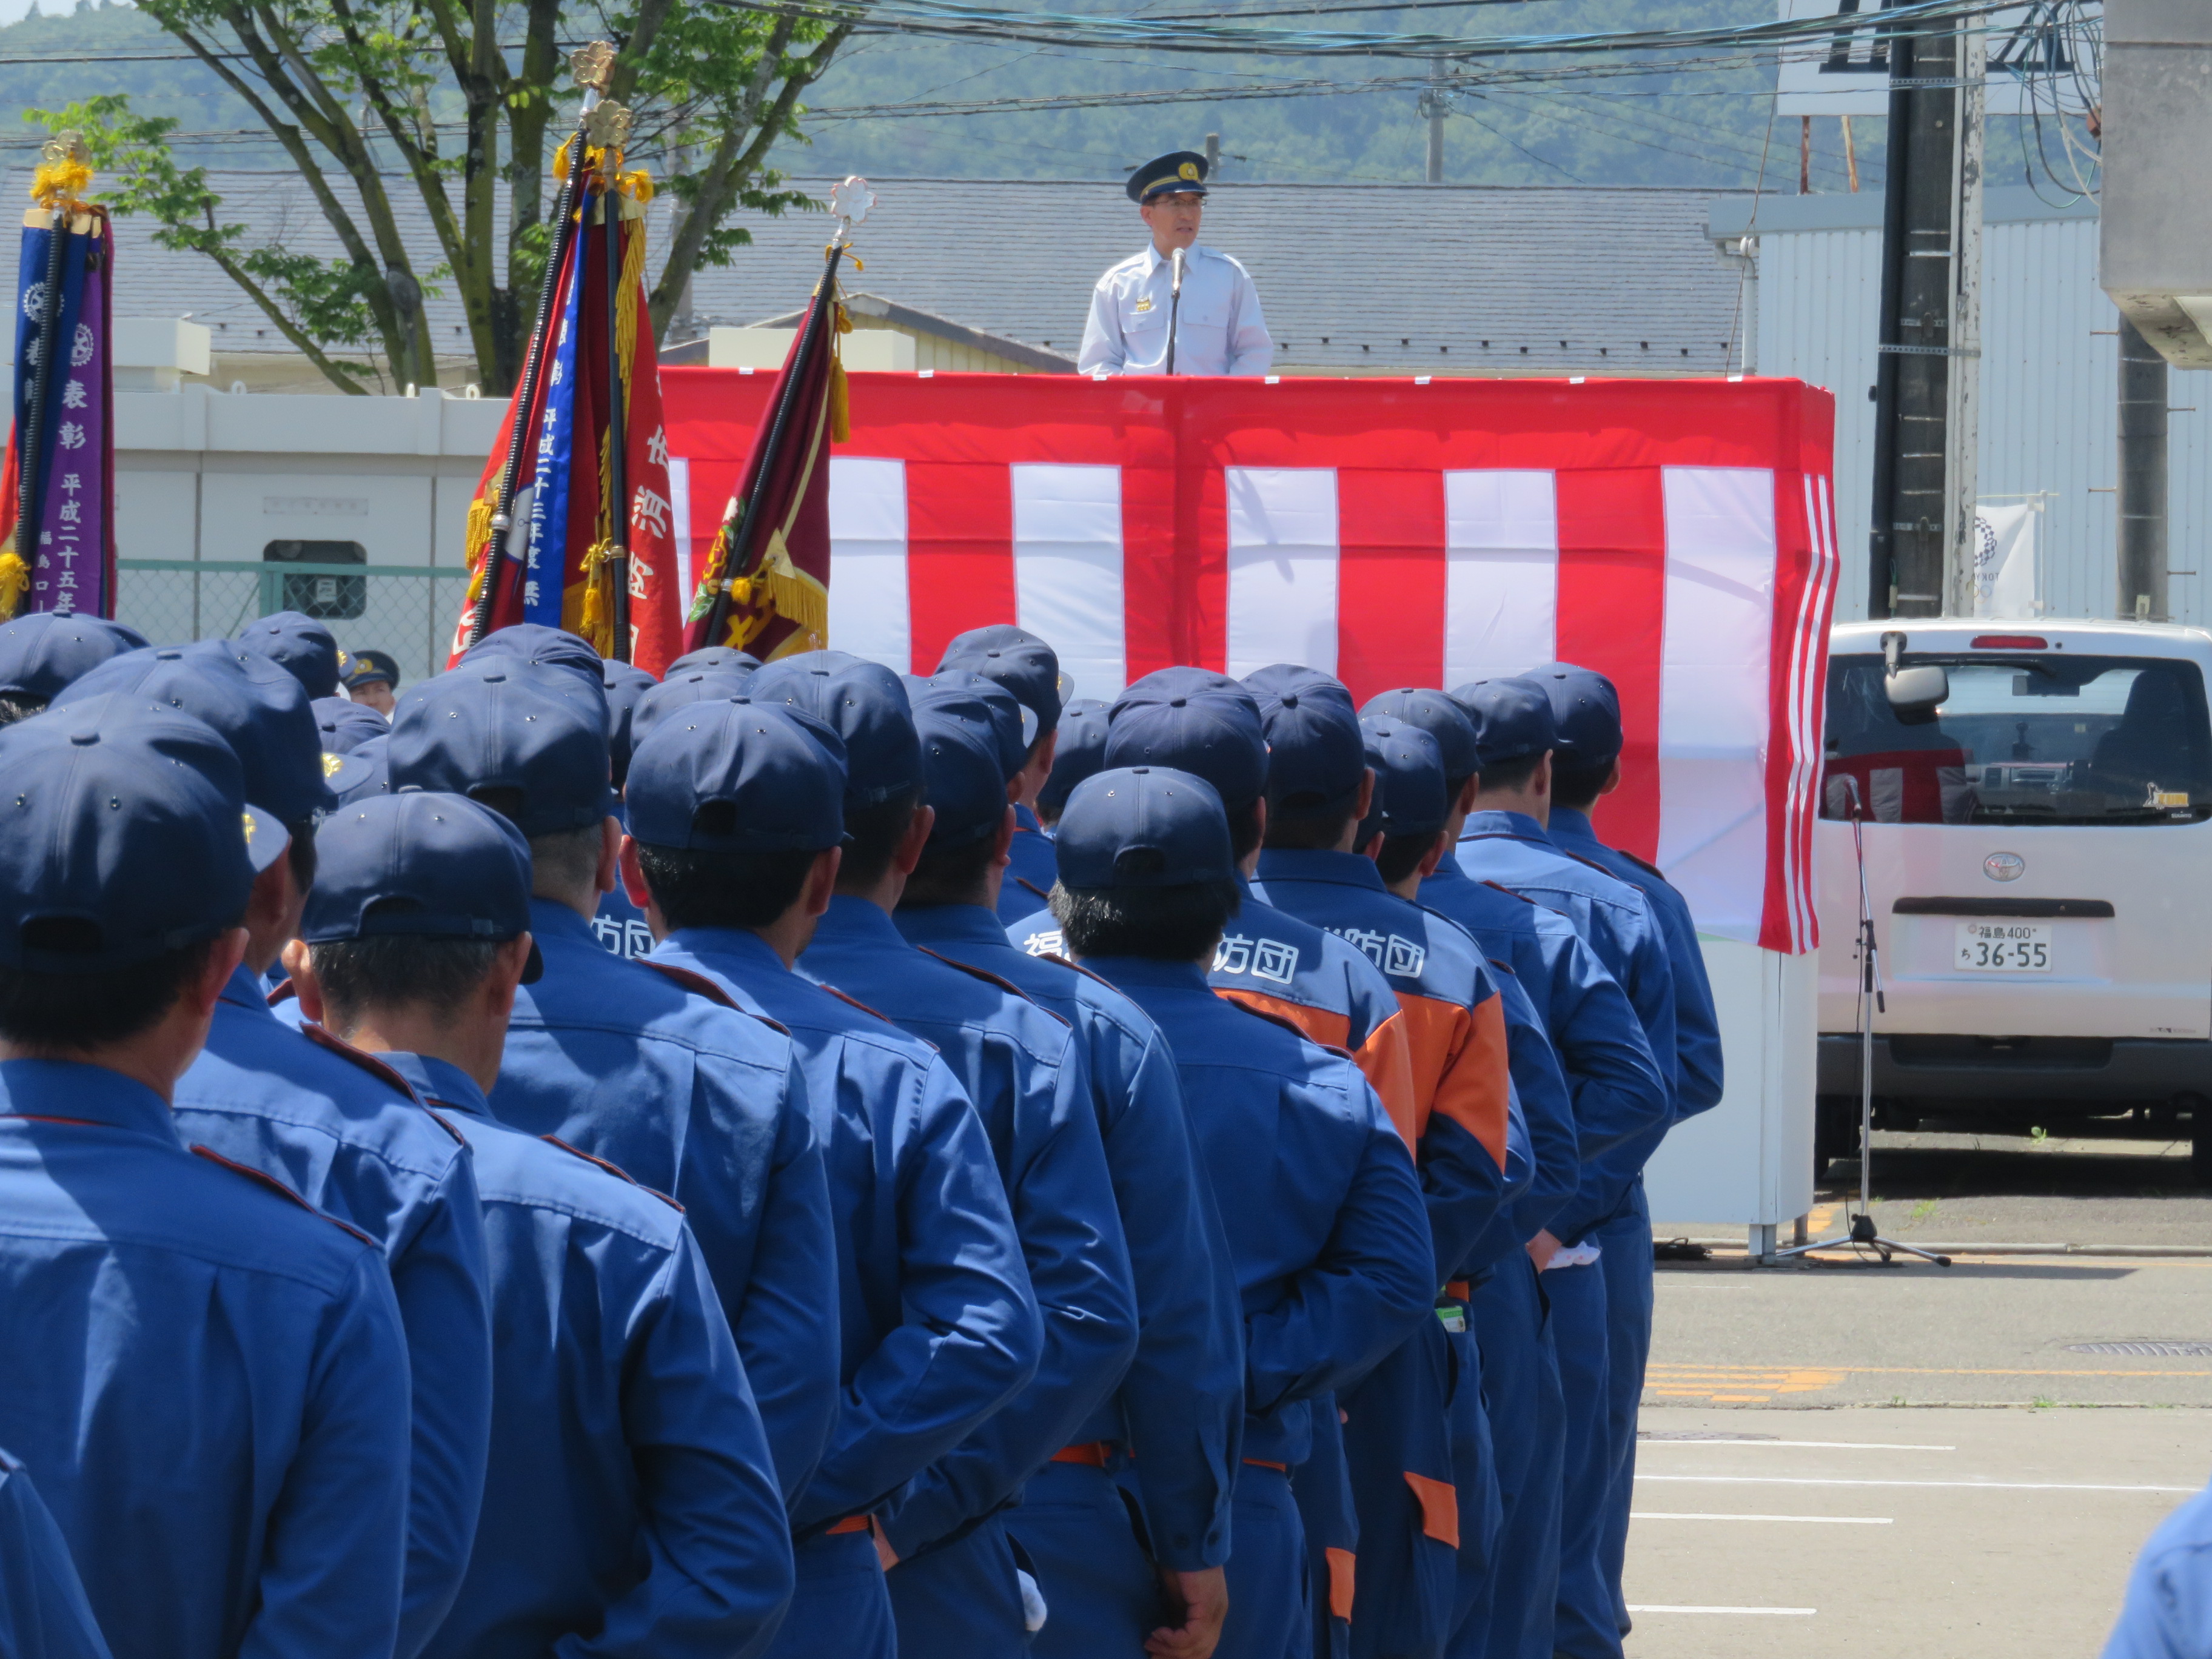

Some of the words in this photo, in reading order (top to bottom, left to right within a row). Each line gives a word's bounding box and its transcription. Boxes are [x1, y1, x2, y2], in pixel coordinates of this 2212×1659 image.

[59, 379, 88, 450] 表彰
[56, 474, 82, 611] 平成二十五年
[1024, 930, 1071, 963] 福
[1324, 927, 1425, 978] 防団
[1960, 948, 1971, 960] ち
[1976, 942, 2046, 968] 36-55
